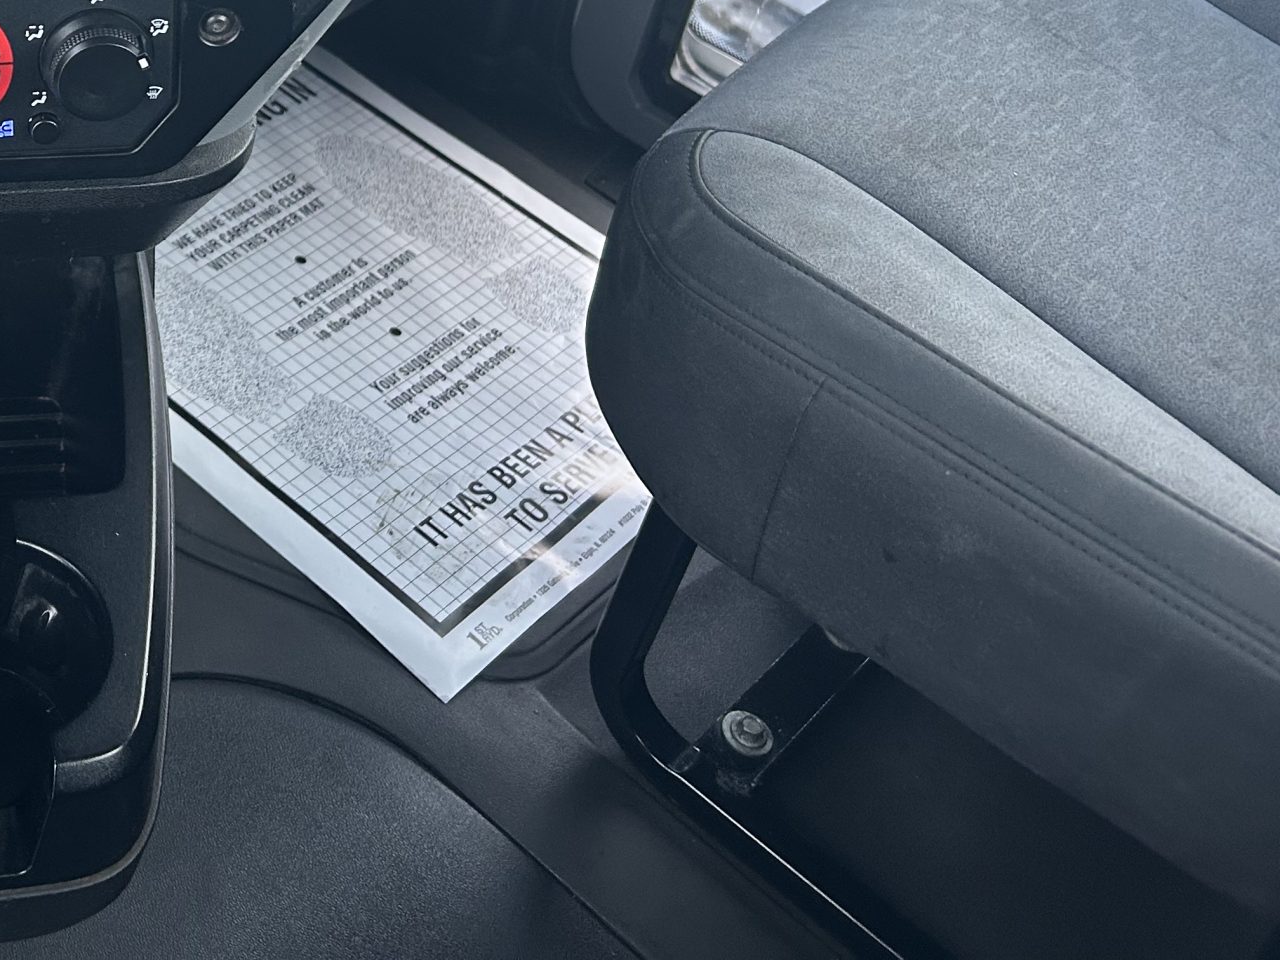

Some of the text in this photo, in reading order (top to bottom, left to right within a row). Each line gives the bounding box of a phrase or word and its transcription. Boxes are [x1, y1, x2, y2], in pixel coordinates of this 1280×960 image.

[186, 182, 316, 261] YOUR CARPETING CLEAN
[191, 216, 225, 238] HAVE
[220, 198, 257, 221] TRIED
[253, 188, 272, 202] TO
[269, 172, 296, 193] KEEP
[207, 197, 325, 271] WITH THIS PAPER MAT
[275, 249, 417, 341] the most important person
[293, 257, 368, 308] A customer is
[313, 329, 332, 341] in
[326, 317, 351, 333] the
[347, 294, 382, 320] world
[377, 287, 394, 300] to
[369, 317, 481, 394] Your suggestions for
[384, 327, 503, 411] improving our service
[407, 405, 431, 424] are
[427, 378, 469, 410] always
[413, 515, 449, 547] IT
[438, 480, 498, 528] HAS
[486, 438, 555, 490] BEEN
[543, 425, 574, 448] A
[503, 497, 549, 532] TO
